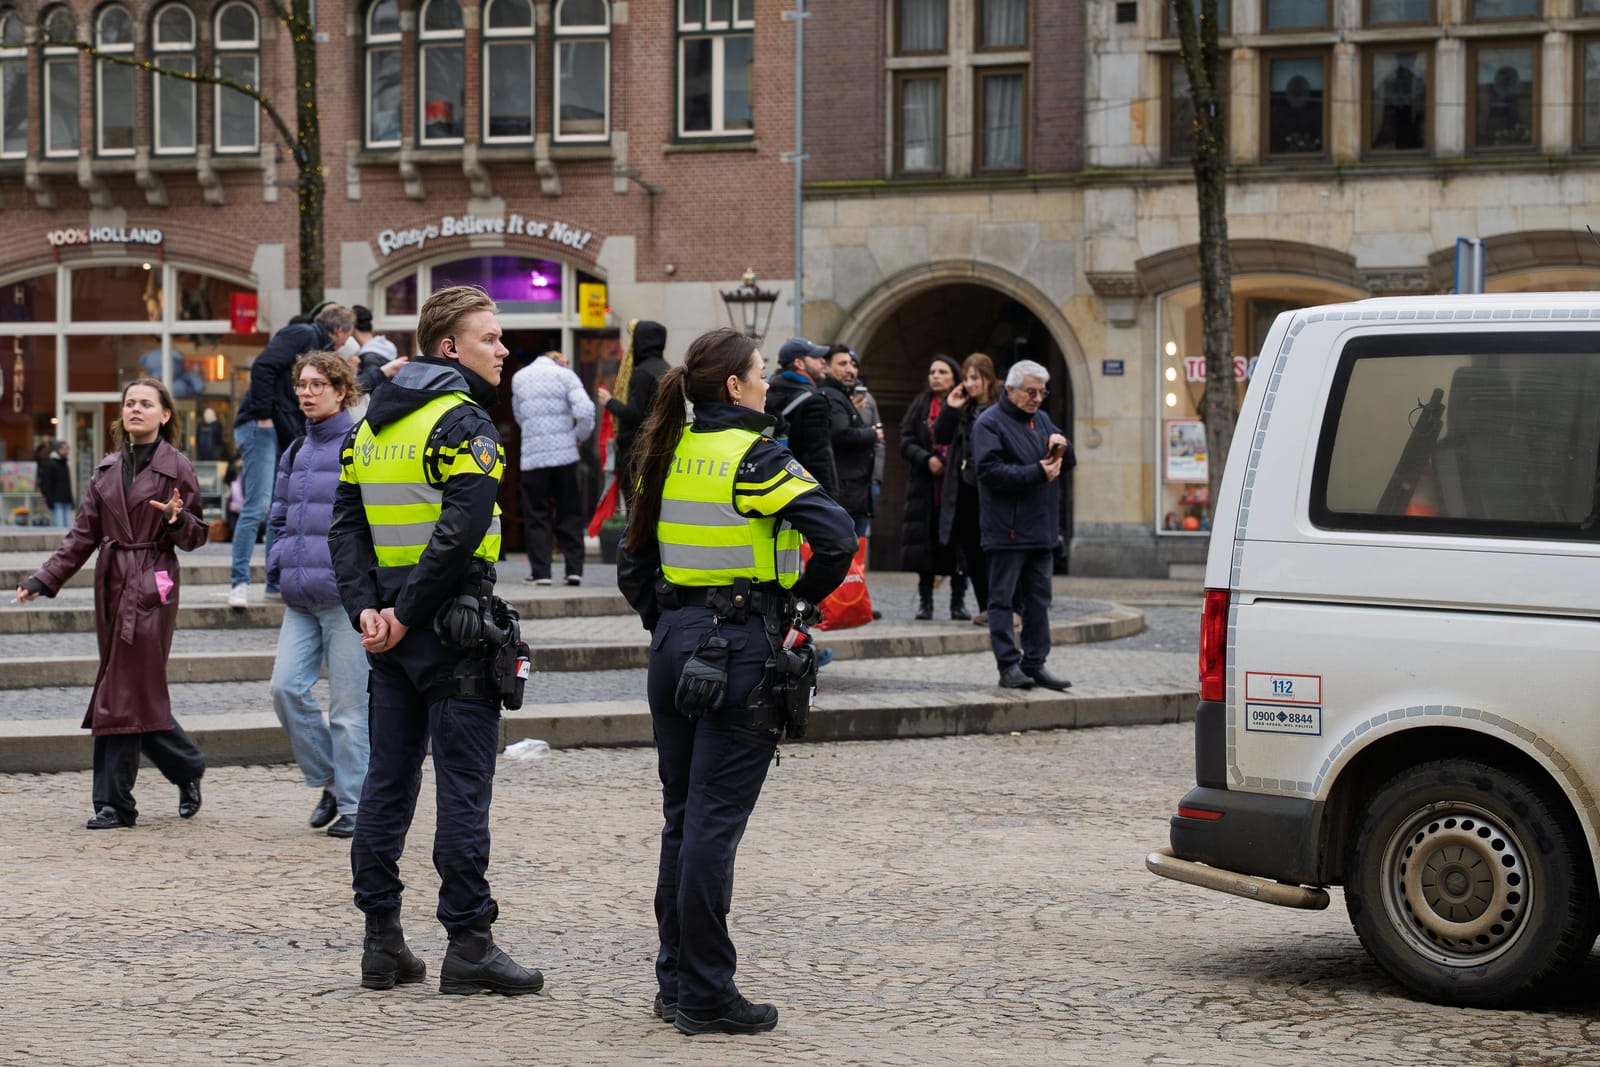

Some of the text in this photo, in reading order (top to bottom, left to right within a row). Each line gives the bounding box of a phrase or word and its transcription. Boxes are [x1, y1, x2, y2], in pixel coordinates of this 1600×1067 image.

[89, 226, 163, 244] HOLLAND
[440, 214, 505, 237] Believe
[507, 213, 524, 235] It
[526, 221, 548, 237] or
[548, 221, 592, 250] Not!
[667, 456, 731, 477] LITIE
[1252, 711, 1313, 724] 0900 8844
